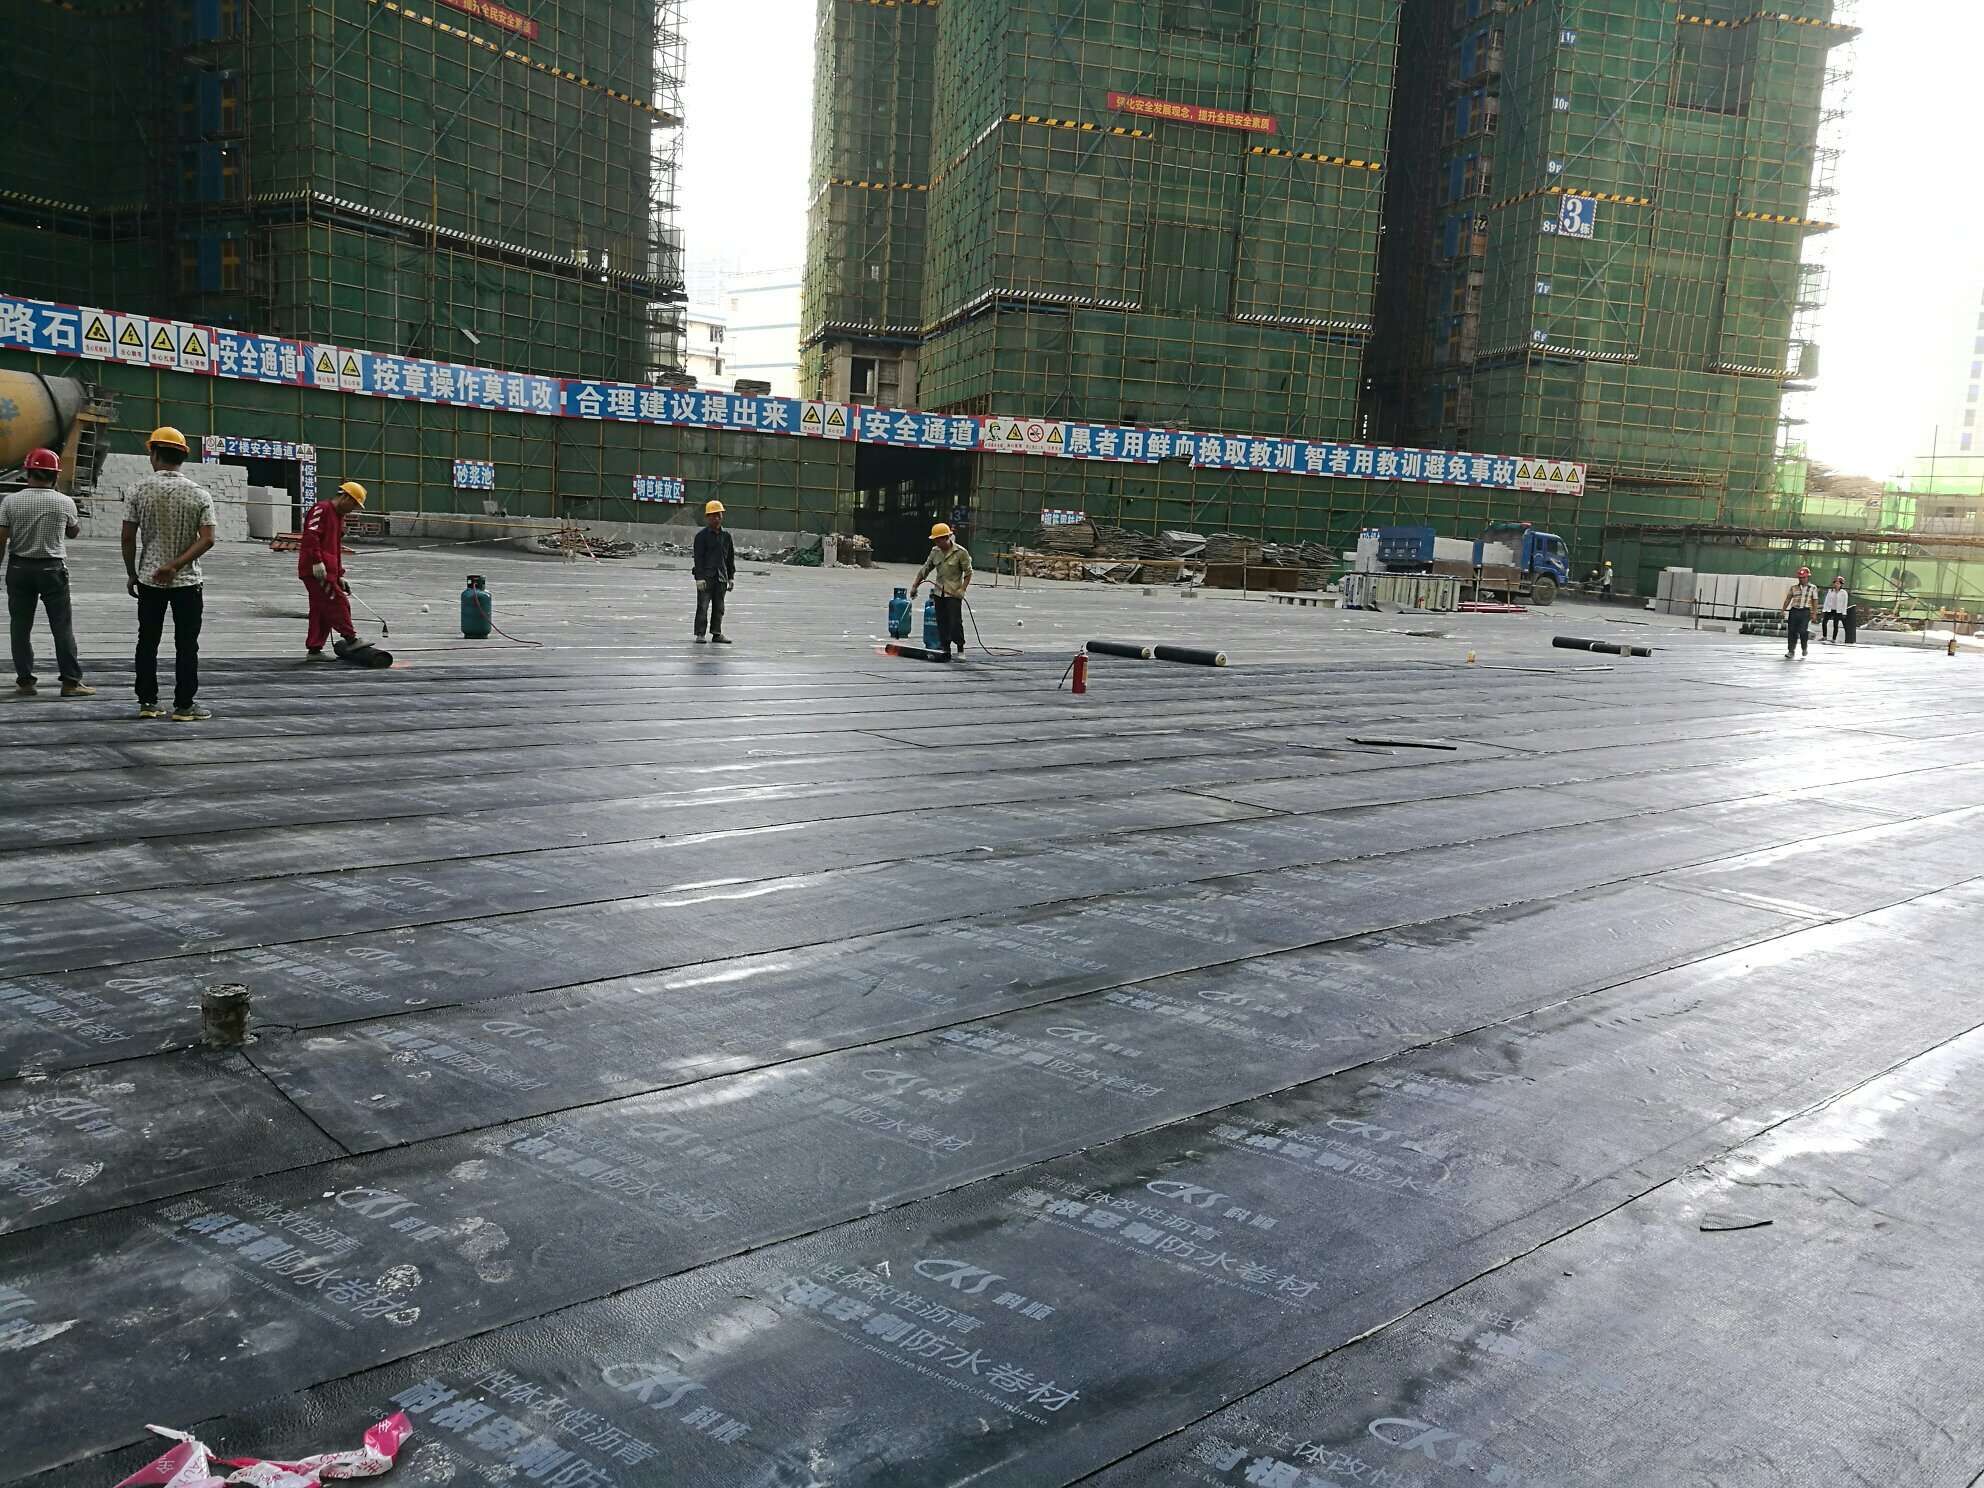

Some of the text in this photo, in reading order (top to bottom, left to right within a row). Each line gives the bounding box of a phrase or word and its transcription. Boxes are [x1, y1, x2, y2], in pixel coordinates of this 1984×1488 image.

[1560, 31, 1576, 45] 11F
[1554, 97, 1569, 110] 10F
[1548, 160, 1563, 174] 9F
[1542, 220, 1558, 233] 8F
[1536, 282, 1551, 295] 7F
[1533, 329, 1549, 343] 6F
[219, 336, 298, 380] 安全通道
[373, 358, 553, 410] 按章操作莫乱改
[576, 385, 789, 429] 合理建议提出来
[865, 411, 975, 447] 安全通道
[456, 464, 494, 485] 砂浆池
[1305, 444, 1514, 484] 智者用教训避免事故
[1145, 1179, 1229, 1210] CKS
[912, 1258, 1009, 1294] CKS
[991, 1290, 1056, 1322] 科顺
